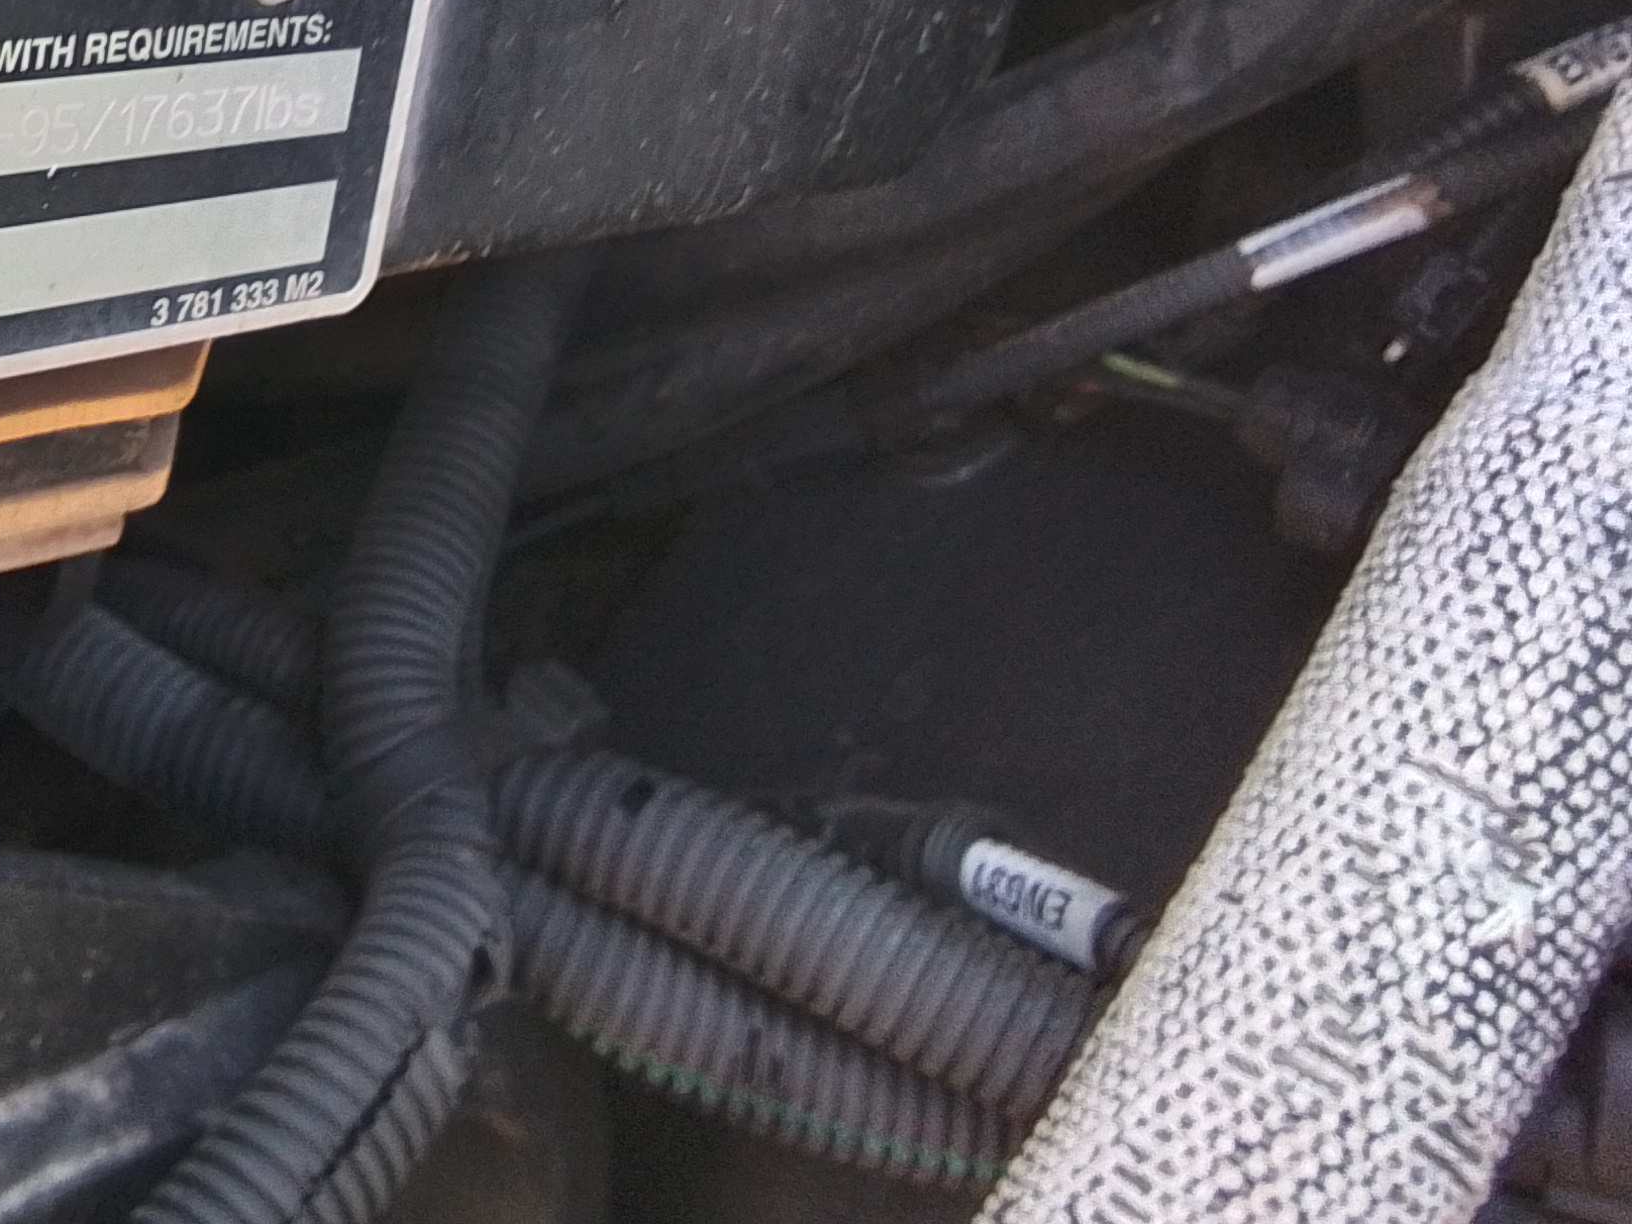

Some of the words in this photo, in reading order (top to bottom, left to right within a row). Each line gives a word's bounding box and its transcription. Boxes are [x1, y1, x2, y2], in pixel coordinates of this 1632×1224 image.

[82, 12, 332, 65] REQUIREMENTS:
[150, 297, 171, 326] 3
[175, 287, 223, 321] 781
[230, 277, 279, 311] 333
[283, 270, 324, 302] M2
